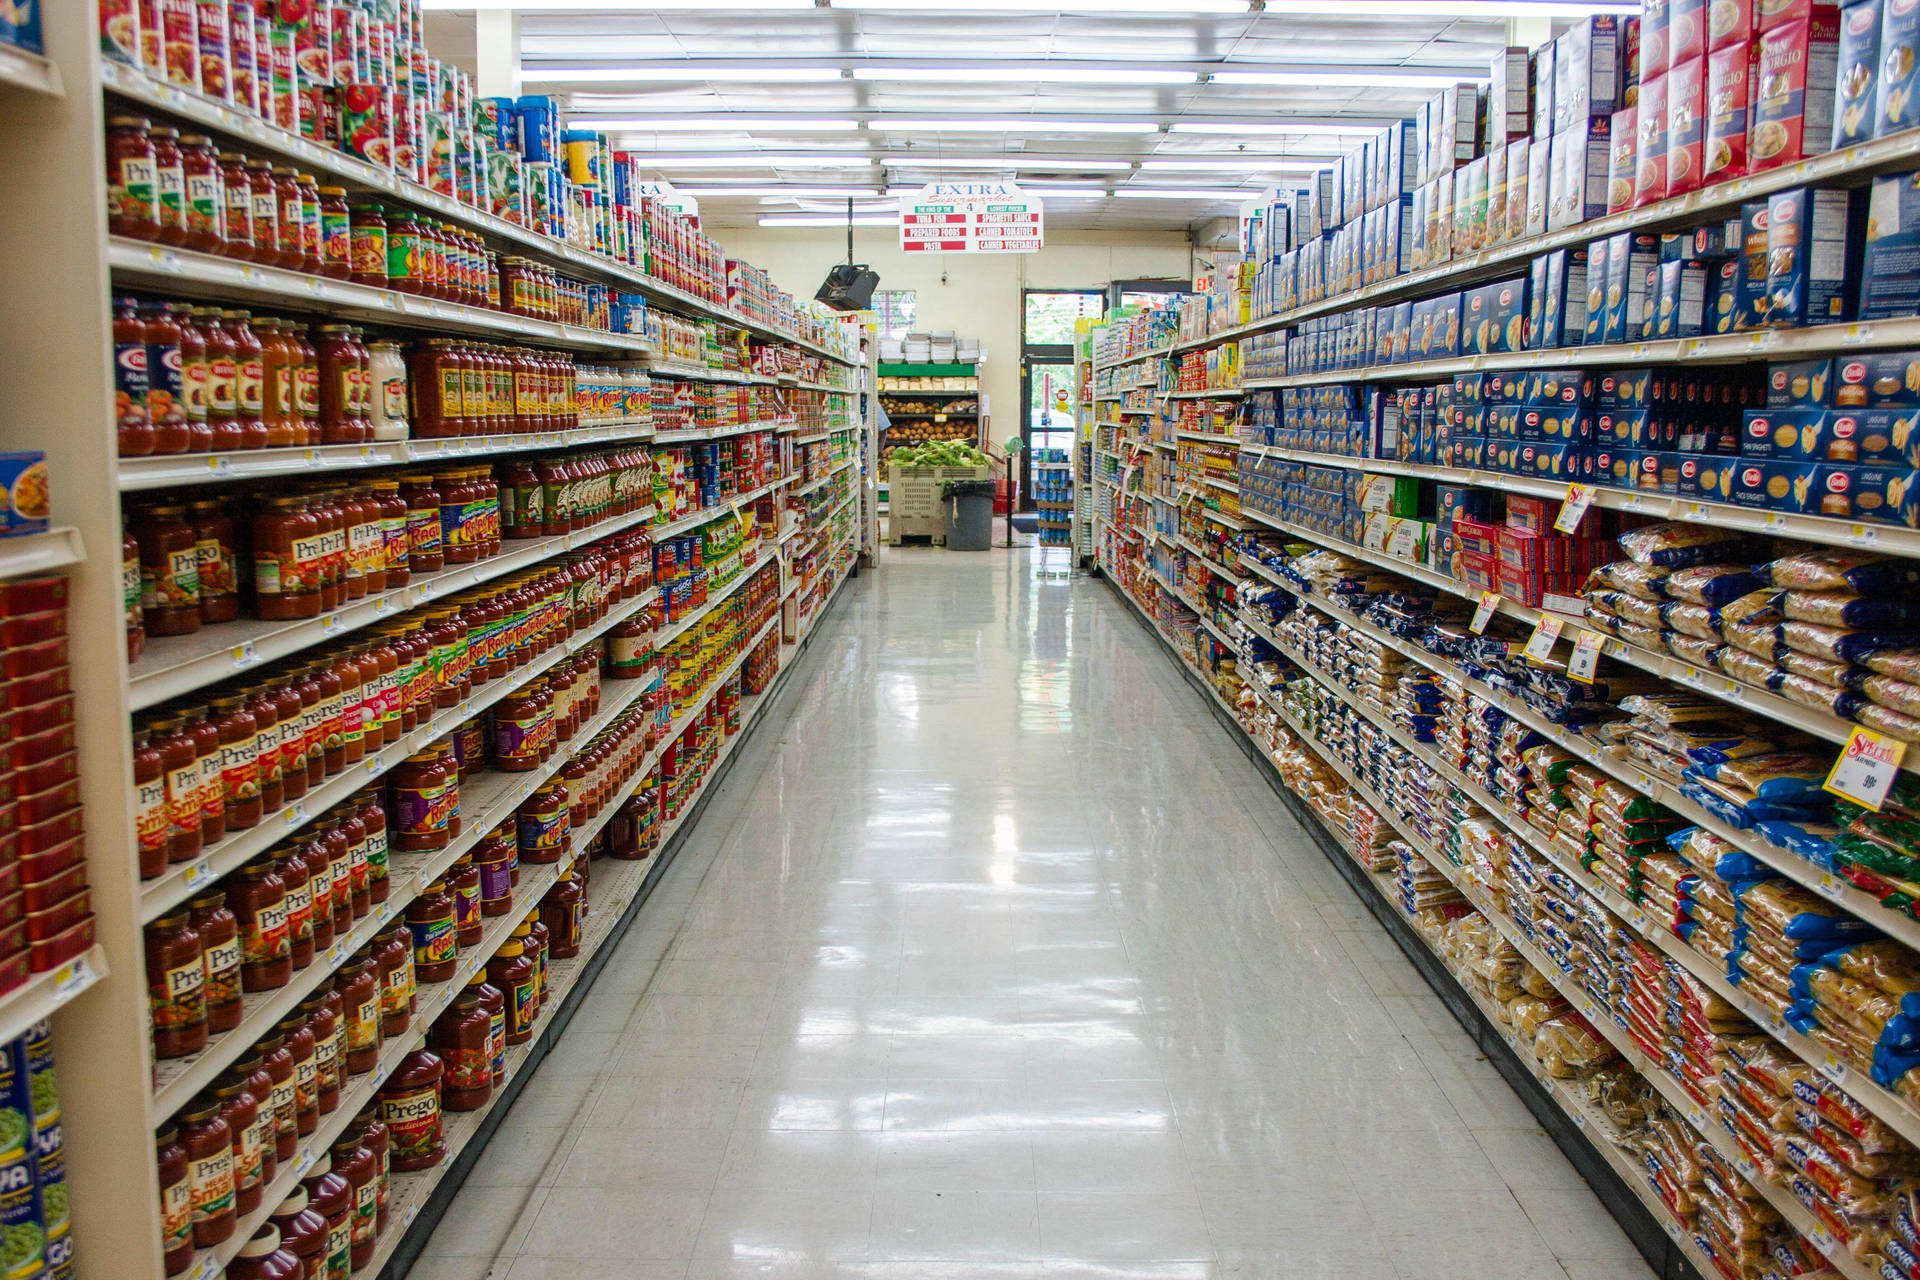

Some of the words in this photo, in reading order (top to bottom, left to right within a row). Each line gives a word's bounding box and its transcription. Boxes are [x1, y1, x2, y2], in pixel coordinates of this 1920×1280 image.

[935, 185, 1007, 195] EXTRA
[926, 193, 1014, 205] Supermarket
[966, 202, 973, 212] 4
[916, 215, 931, 224] TUNA
[982, 214, 1012, 223] SPAGHETTI
[1014, 214, 1031, 223] SAUCE
[910, 228, 939, 237] PREPARED
[940, 228, 960, 237] FOODS
[979, 228, 1001, 237] CANNED
[1003, 228, 1033, 236] TOMATOES
[924, 242, 942, 251] PASTA
[981, 241, 1003, 250] CANNED
[1005, 240, 1039, 249] VEGETABLES
[1793, 1081, 1818, 1104] GOYA
[384, 1097, 437, 1121] Prego
[1886, 1240, 1914, 1268] GOYA
